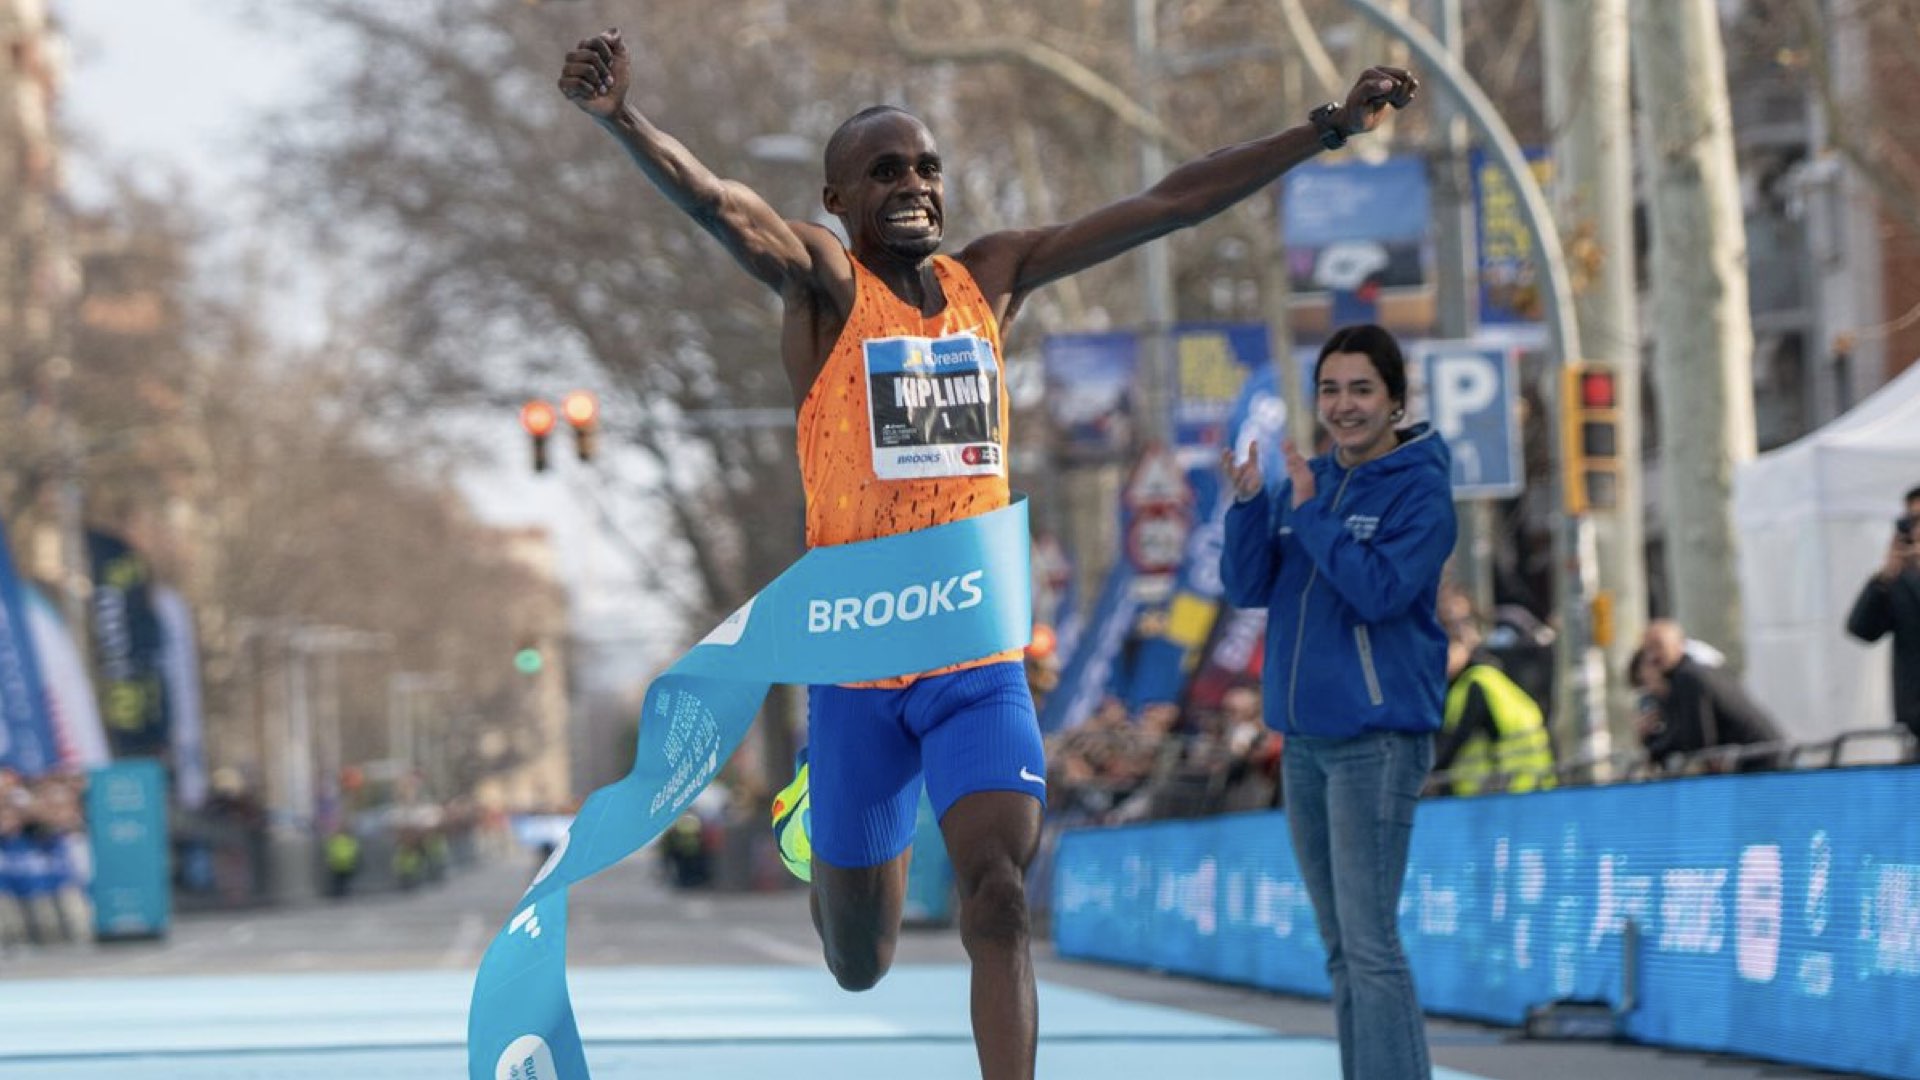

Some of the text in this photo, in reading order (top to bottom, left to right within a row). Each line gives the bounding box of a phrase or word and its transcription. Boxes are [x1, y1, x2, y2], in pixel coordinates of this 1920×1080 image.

[894, 374, 991, 408] KIPLIMO
[1434, 357, 1498, 438] P
[896, 452, 941, 465] BROOKS
[807, 569, 984, 634] BROOKS
